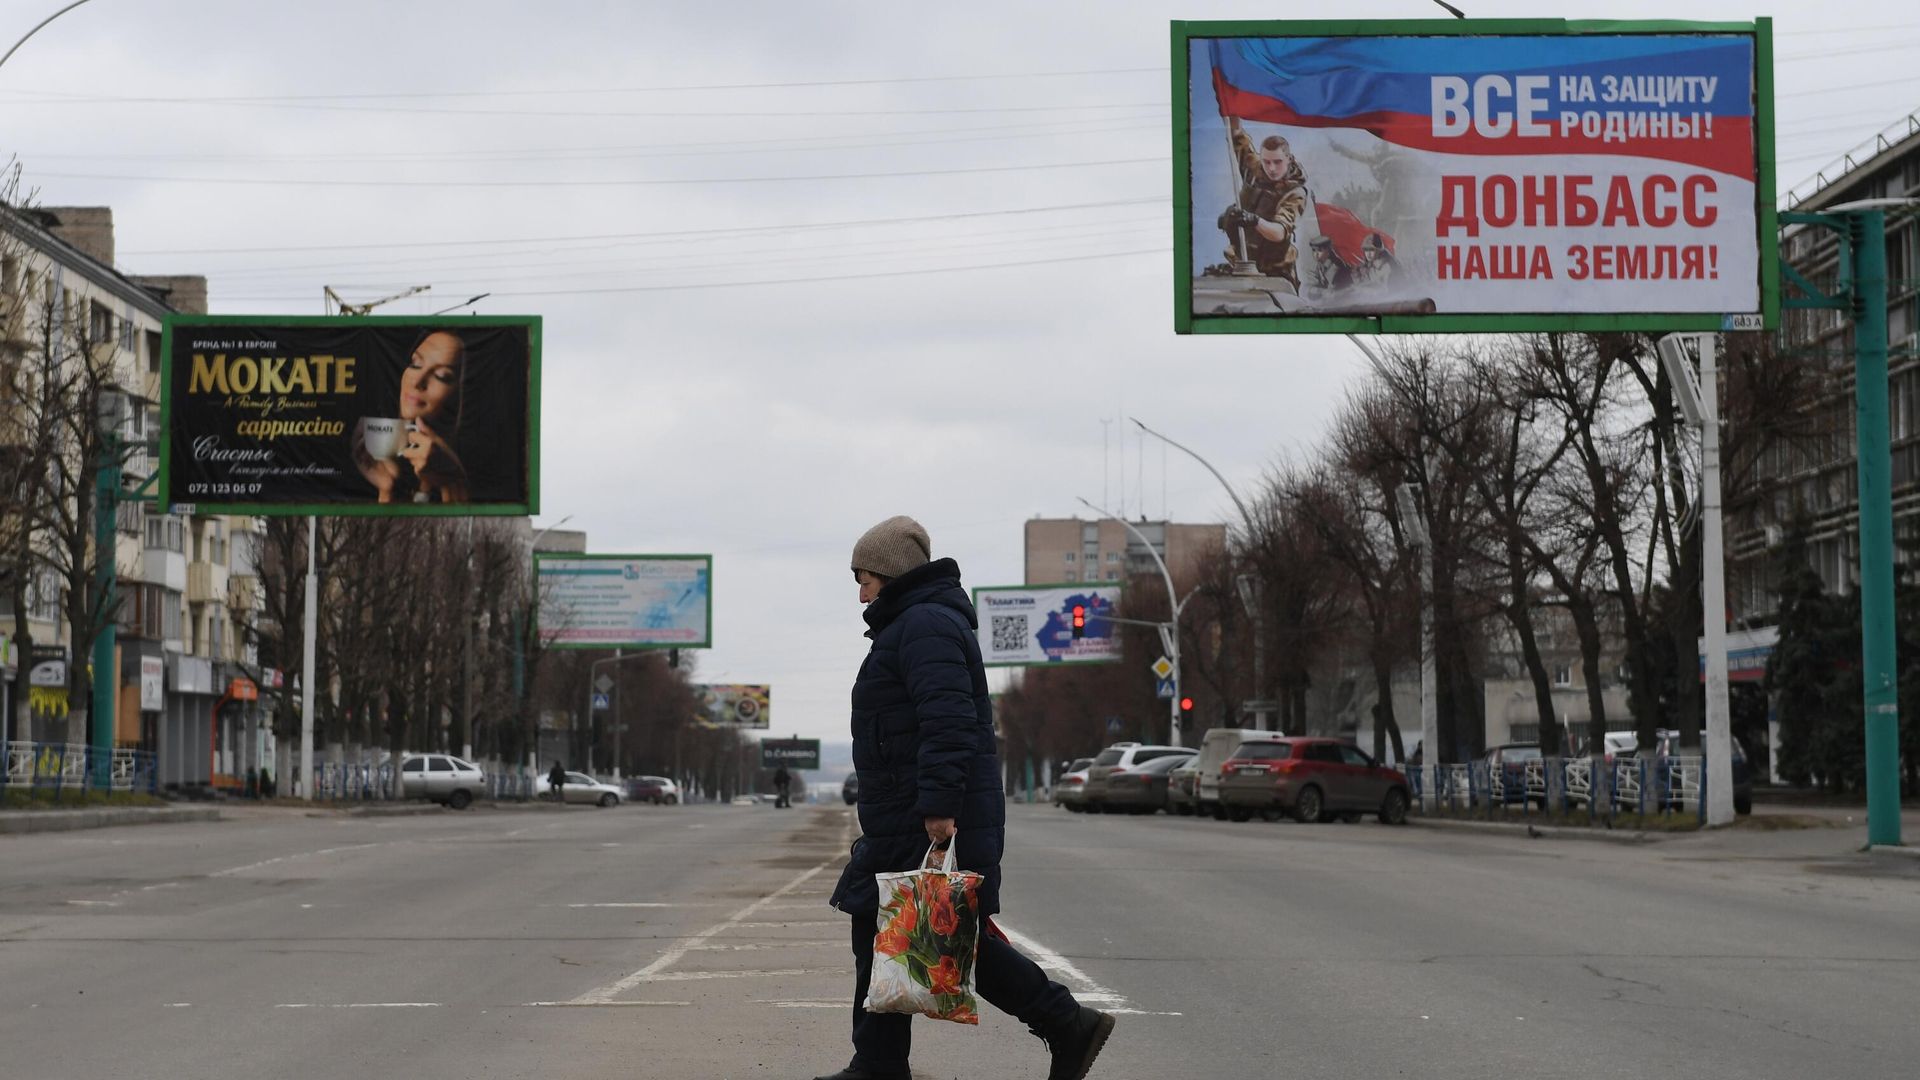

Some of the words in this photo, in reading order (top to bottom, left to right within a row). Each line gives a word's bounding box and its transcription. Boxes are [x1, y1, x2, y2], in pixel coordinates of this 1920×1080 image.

[1560, 77, 1597, 103] НА
[1602, 75, 1718, 106] ЗАЩИТУ
[1431, 75, 1550, 138] ВСЕ
[1560, 111, 1713, 143] РОДИНЫ!
[1436, 174, 1718, 237] ДОНБАСС
[1437, 244, 1553, 280] НАША
[1567, 243, 1718, 280] ЗЕМЛЯ!
[193, 340, 219, 349] БРЕНД
[245, 340, 277, 349] ЕВРОПЕ
[189, 353, 357, 393] MOKATE
[235, 395, 274, 416] Family
[276, 395, 317, 412] Business
[238, 417, 345, 439] cappuccino
[193, 434, 274, 462] Счастье
[189, 483, 208, 494] 072
[212, 483, 230, 494] 123
[233, 483, 246, 494] 05
[248, 483, 262, 494] 07
